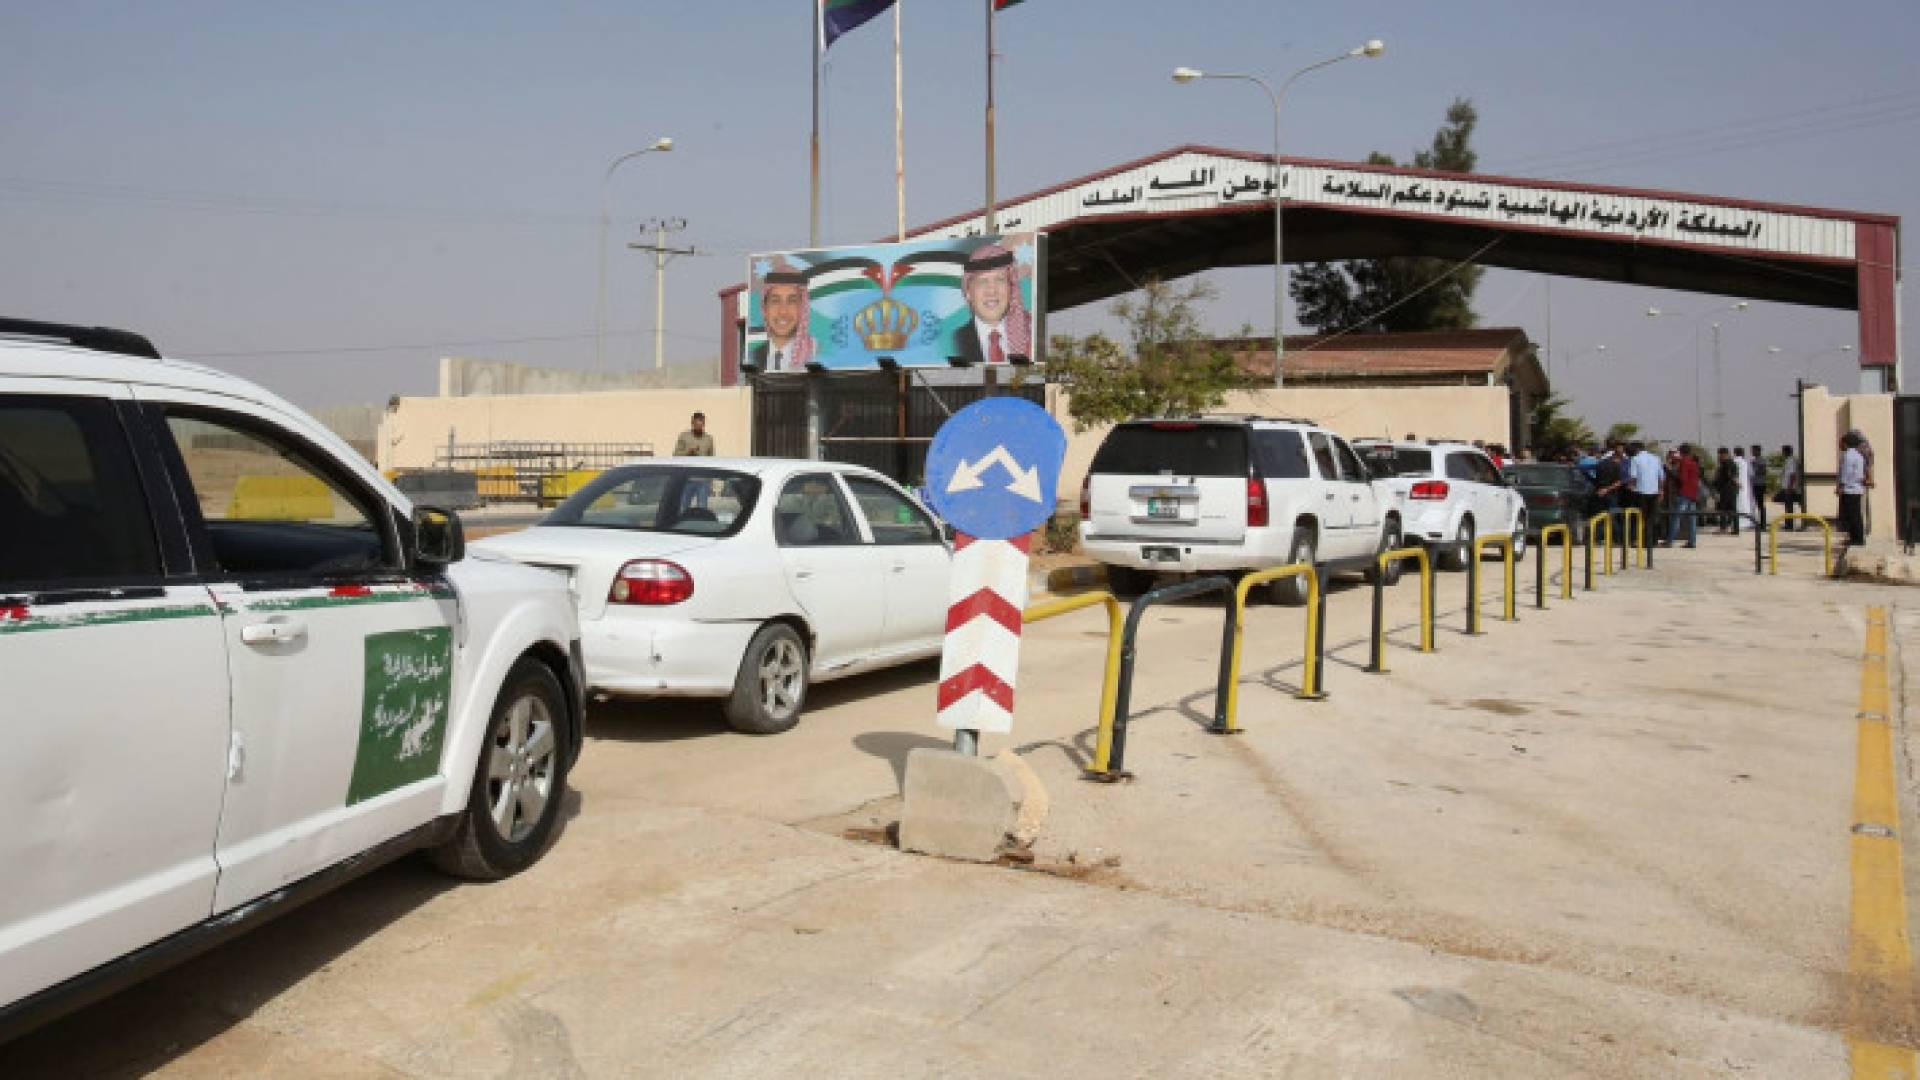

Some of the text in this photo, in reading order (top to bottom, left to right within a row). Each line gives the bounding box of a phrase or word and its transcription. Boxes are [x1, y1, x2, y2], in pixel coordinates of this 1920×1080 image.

[1150, 166, 1215, 190] الله
[1322, 175, 1391, 200] السلامة
[1498, 193, 1587, 223] الهاشمية
[1677, 209, 1762, 239] المملكة
